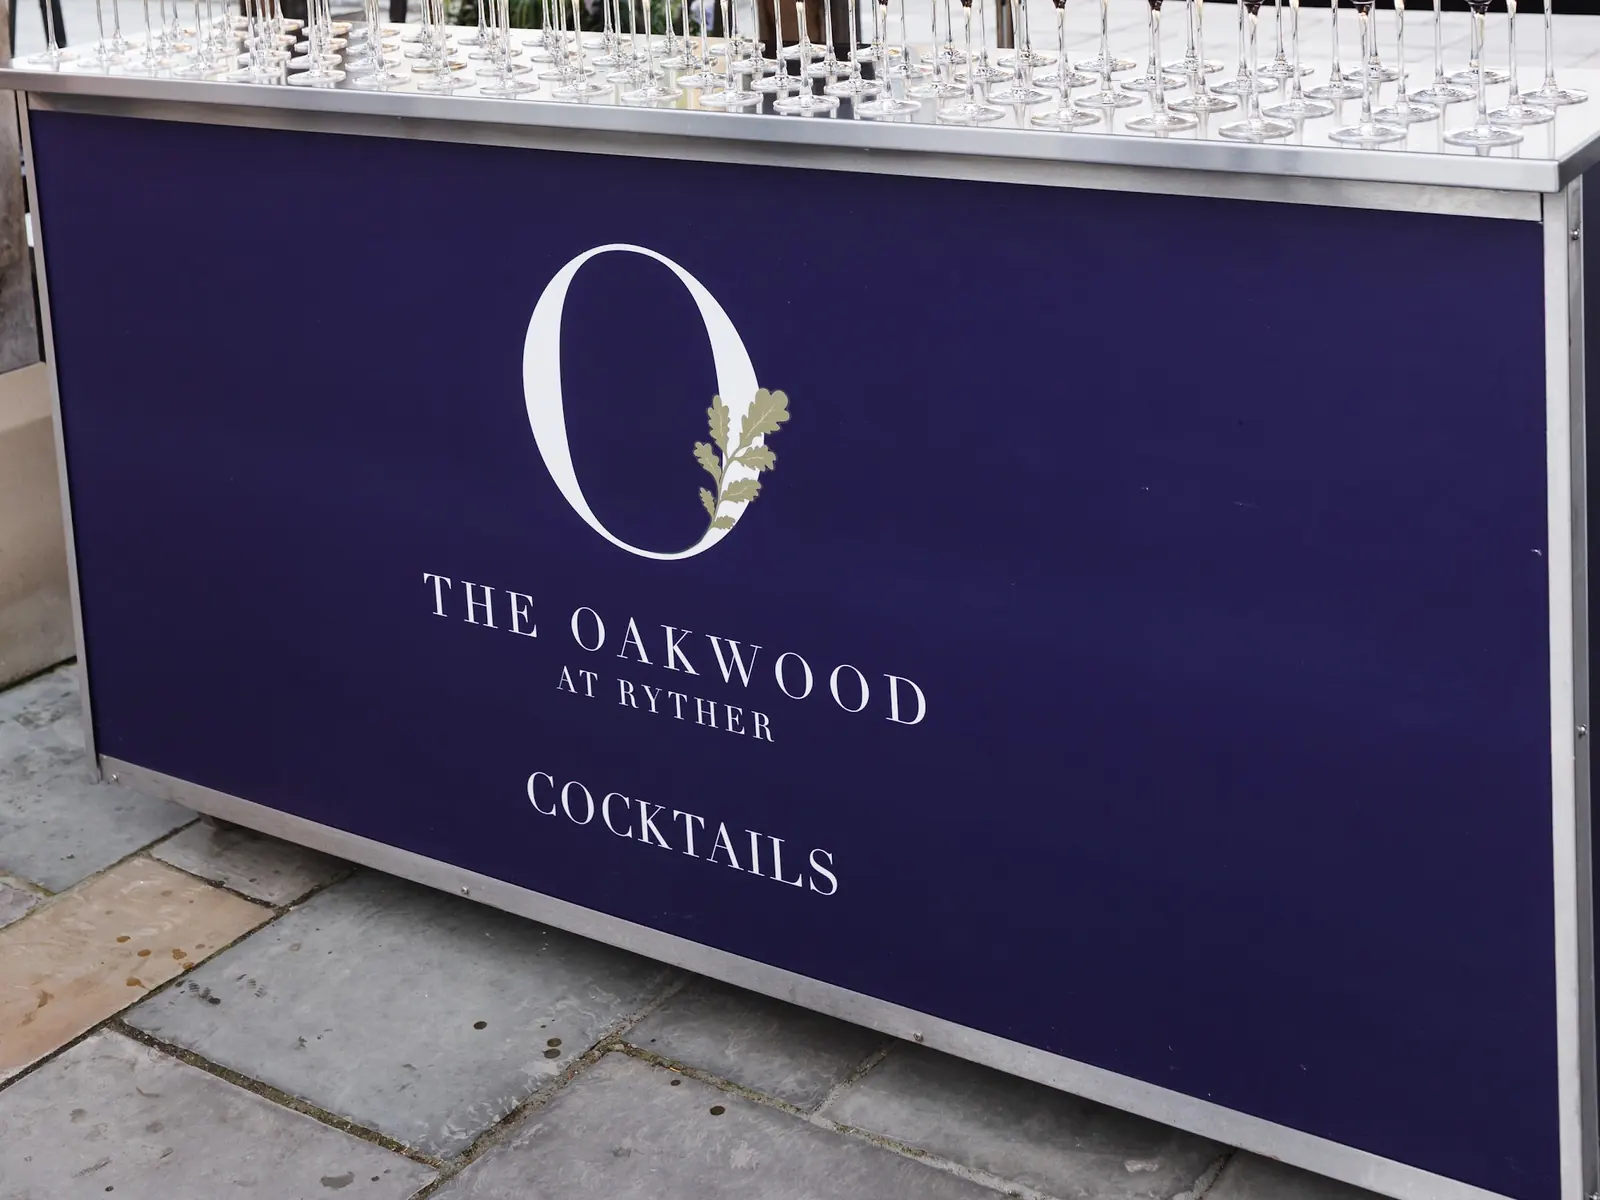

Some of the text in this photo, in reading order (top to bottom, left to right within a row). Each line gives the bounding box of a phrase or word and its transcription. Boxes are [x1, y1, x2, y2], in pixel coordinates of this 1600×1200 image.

[423, 572, 927, 726] THE OAKWOOD
[556, 664, 775, 743] AT RYTHER
[526, 771, 839, 897] COCKTAILS
